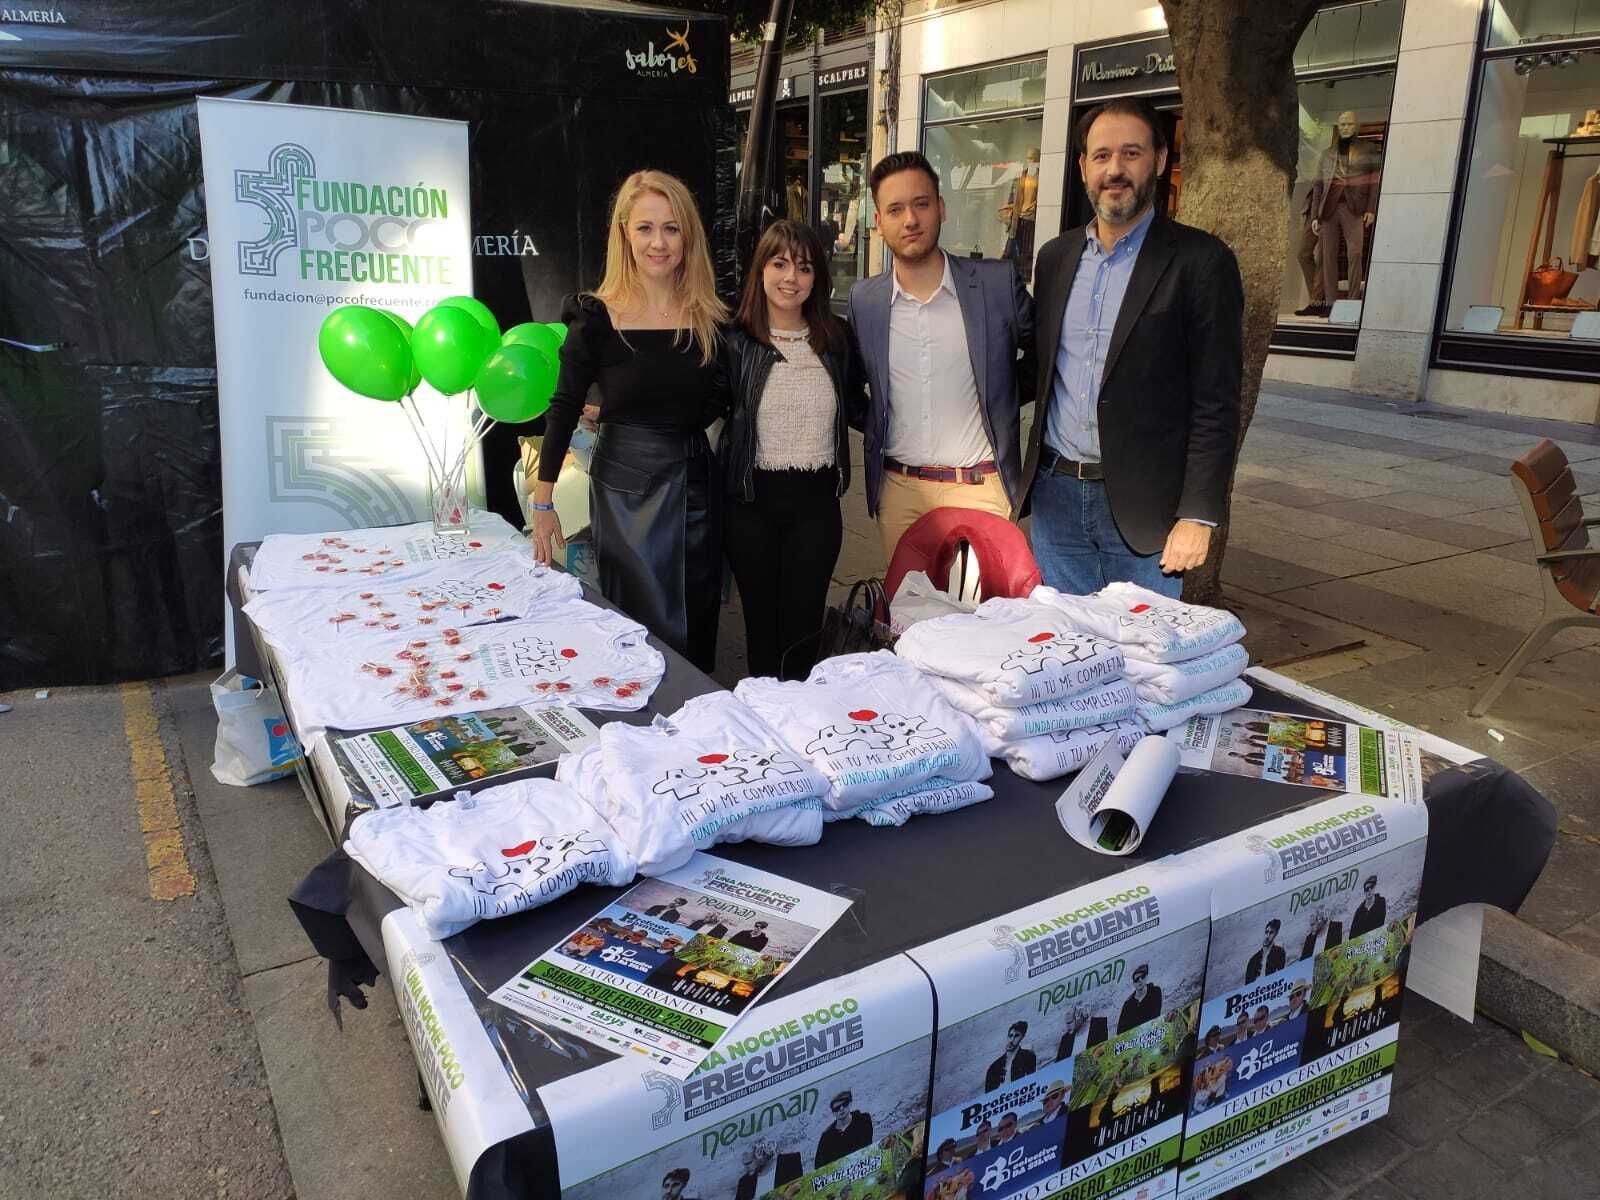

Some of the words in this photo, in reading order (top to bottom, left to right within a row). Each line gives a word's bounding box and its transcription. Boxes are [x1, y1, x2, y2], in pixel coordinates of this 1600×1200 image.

[1, 9, 66, 24] ALMERÍA
[625, 41, 698, 75] sabores
[818, 66, 867, 86] SCALPERS
[1143, 52, 1176, 75] Dutt
[297, 180, 448, 219] FUNDACIÓN
[299, 251, 453, 285] FRECUENTE
[1268, 832, 1301, 849] UNA
[1297, 816, 1343, 839] NOCHE
[1339, 805, 1376, 824] POCO
[1278, 813, 1387, 870] FRECUENTE
[707, 879, 797, 910] FRECUENTE
[1013, 922, 1055, 943] UNA
[1050, 901, 1110, 928] NOCHE
[1106, 885, 1150, 910] POCO
[1024, 896, 1161, 968] FRECUENTE
[573, 963, 625, 986] TEATRO
[626, 978, 707, 1016] CERVANTES
[726, 1018, 802, 1061] NOCHE
[801, 997, 860, 1030] POCO
[682, 1014, 864, 1110] FRECUENTE
[1223, 1079, 1284, 1118] TEATRO
[1286, 1039, 1372, 1087] CERVANTES
[1269, 1101, 1284, 1117] DE
[1285, 1075, 1336, 1110] FEBRERO
[1045, 1132, 1151, 1192] CERVANTES
